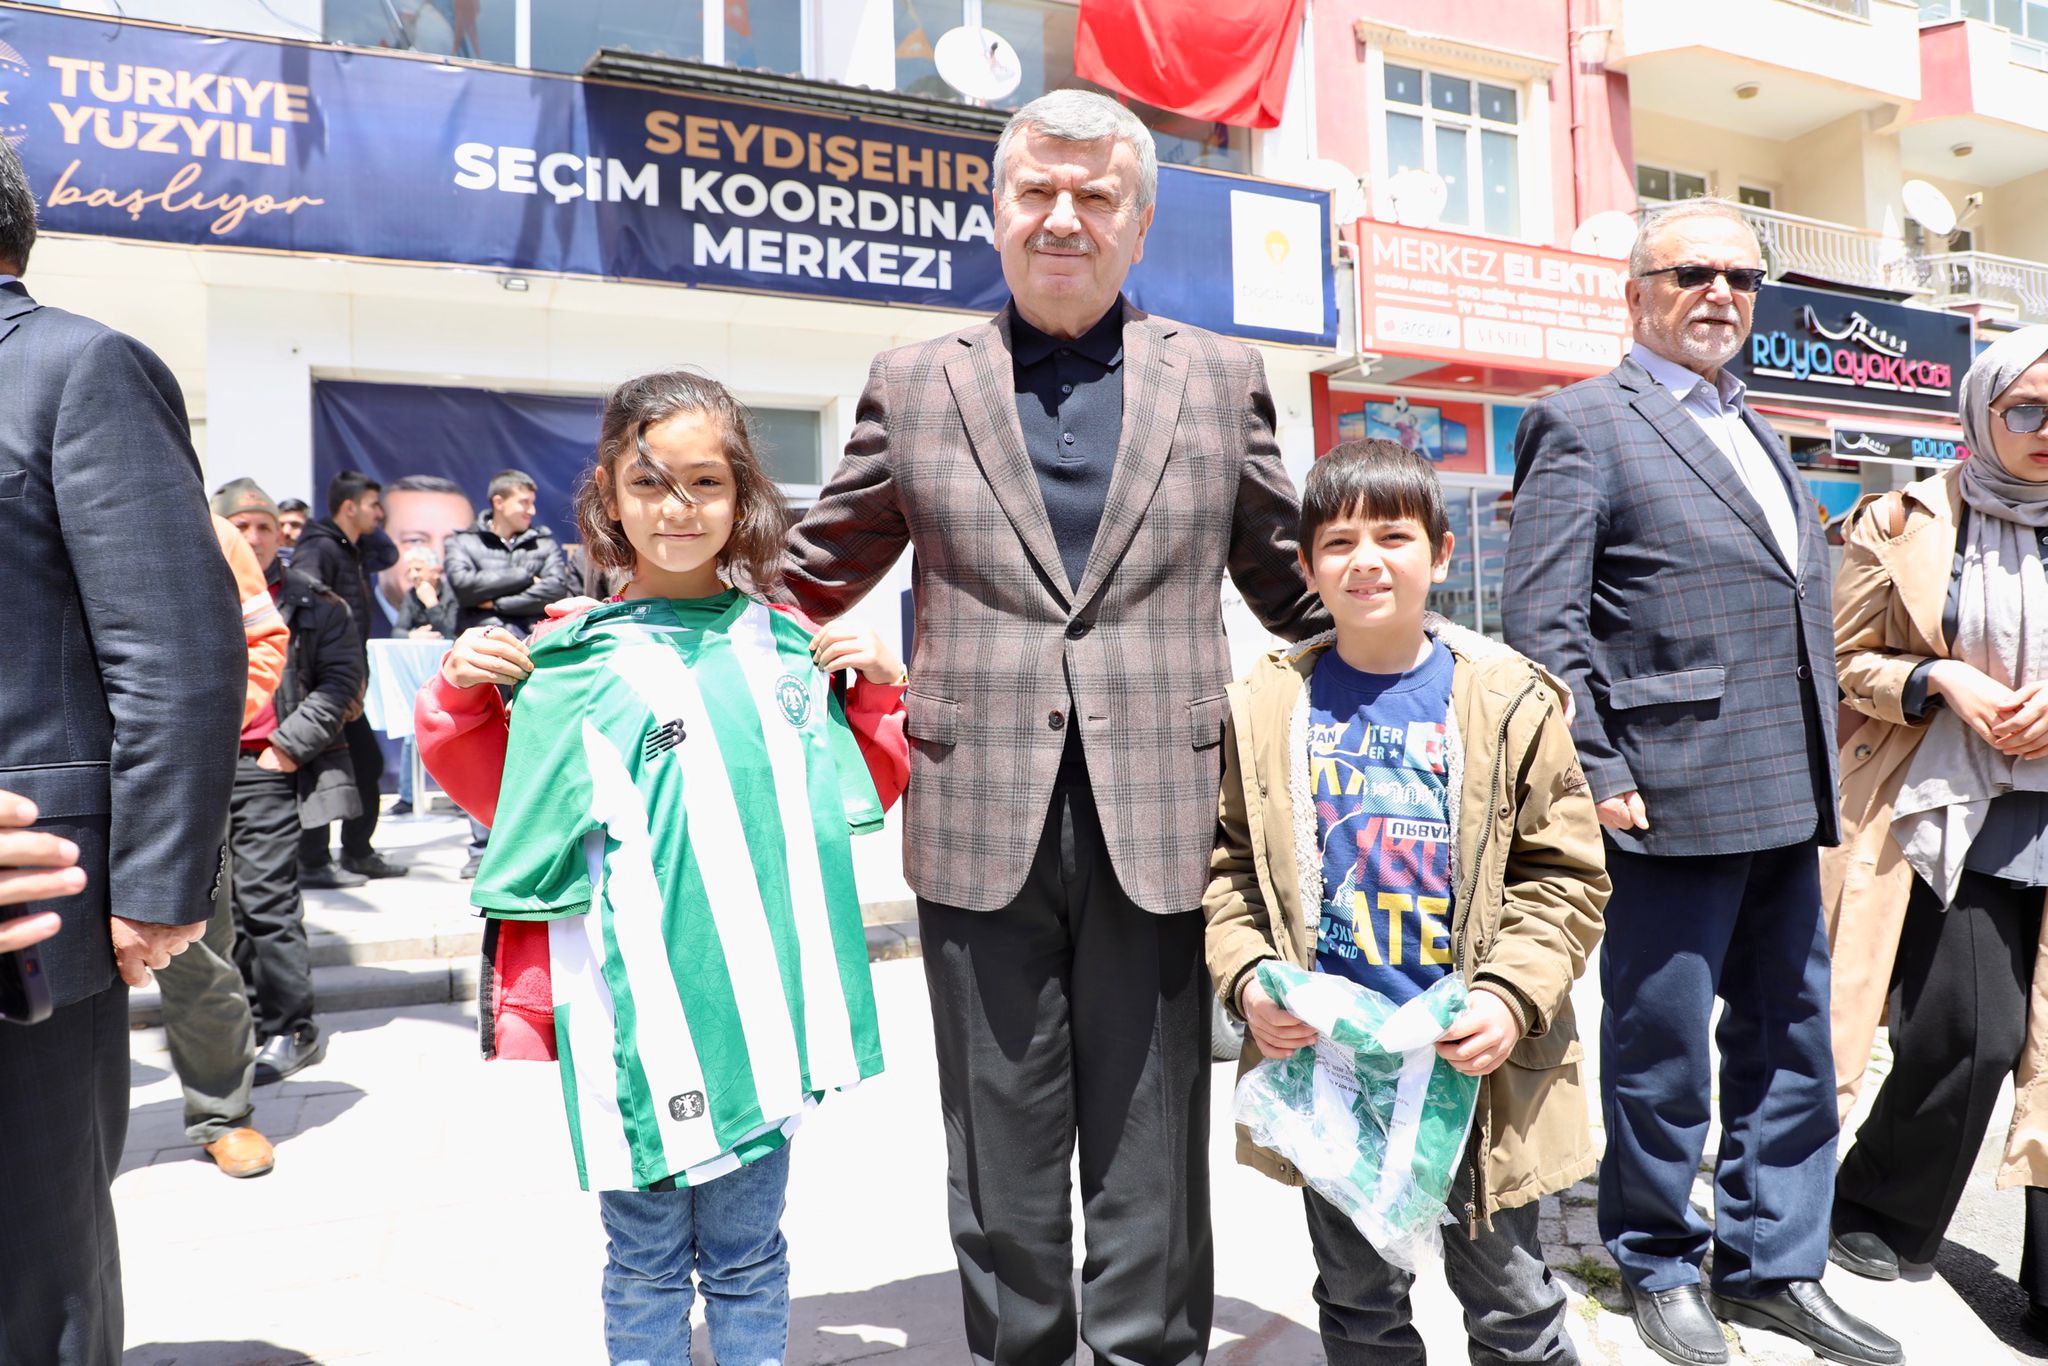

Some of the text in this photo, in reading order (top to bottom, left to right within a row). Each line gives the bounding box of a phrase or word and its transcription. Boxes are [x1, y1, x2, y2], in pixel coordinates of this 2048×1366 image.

[48, 56, 310, 123] TÜRKİYE
[48, 102, 287, 166] YÜZYILI
[645, 110, 990, 195] SEYDİŞEHİR
[47, 160, 325, 235] başlıyor
[454, 142, 661, 205] SEÇİM
[693, 223, 952, 290] MERKEZİ
[1373, 234, 1498, 282] MERKEZ
